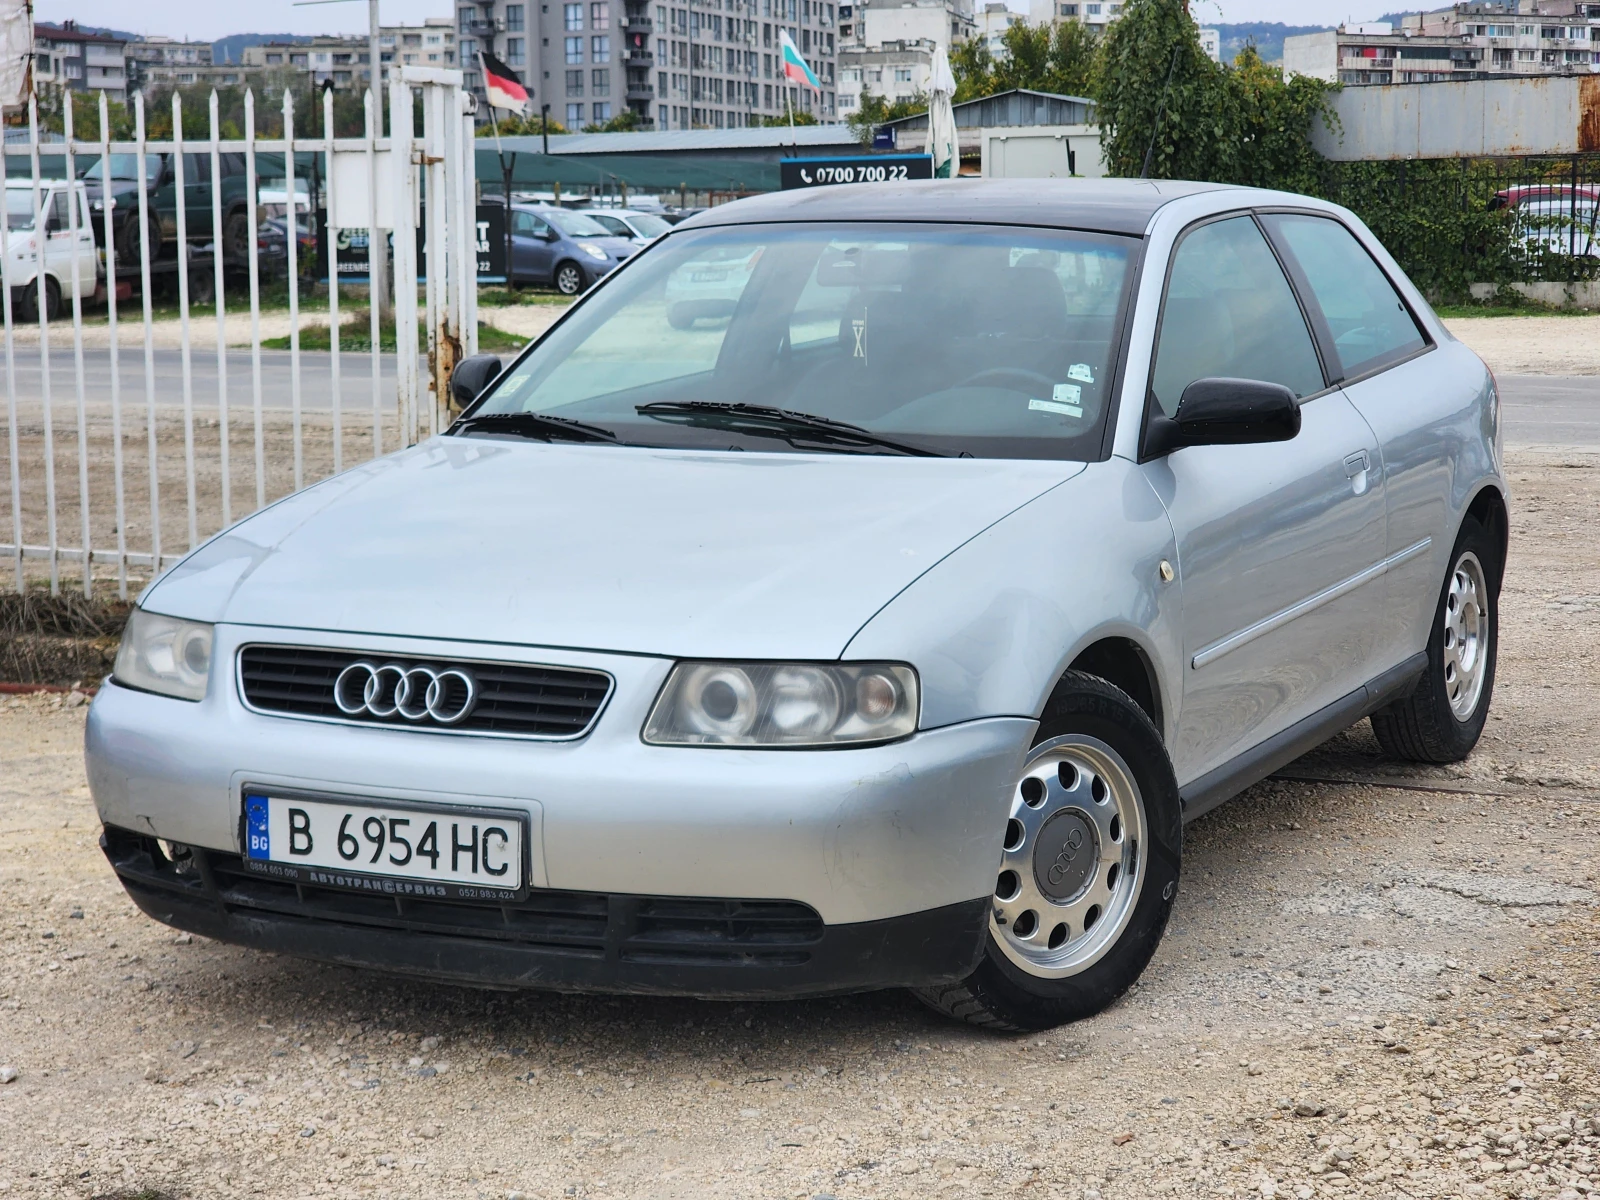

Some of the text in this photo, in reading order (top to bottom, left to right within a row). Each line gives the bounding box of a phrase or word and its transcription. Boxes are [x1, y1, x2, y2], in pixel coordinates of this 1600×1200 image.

[816, 165, 908, 183] 0700 700 22
[251, 835, 268, 851] BG
[310, 872, 447, 896] АВТОТРАНСЕРВИЗ
[498, 891, 515, 900] 424
